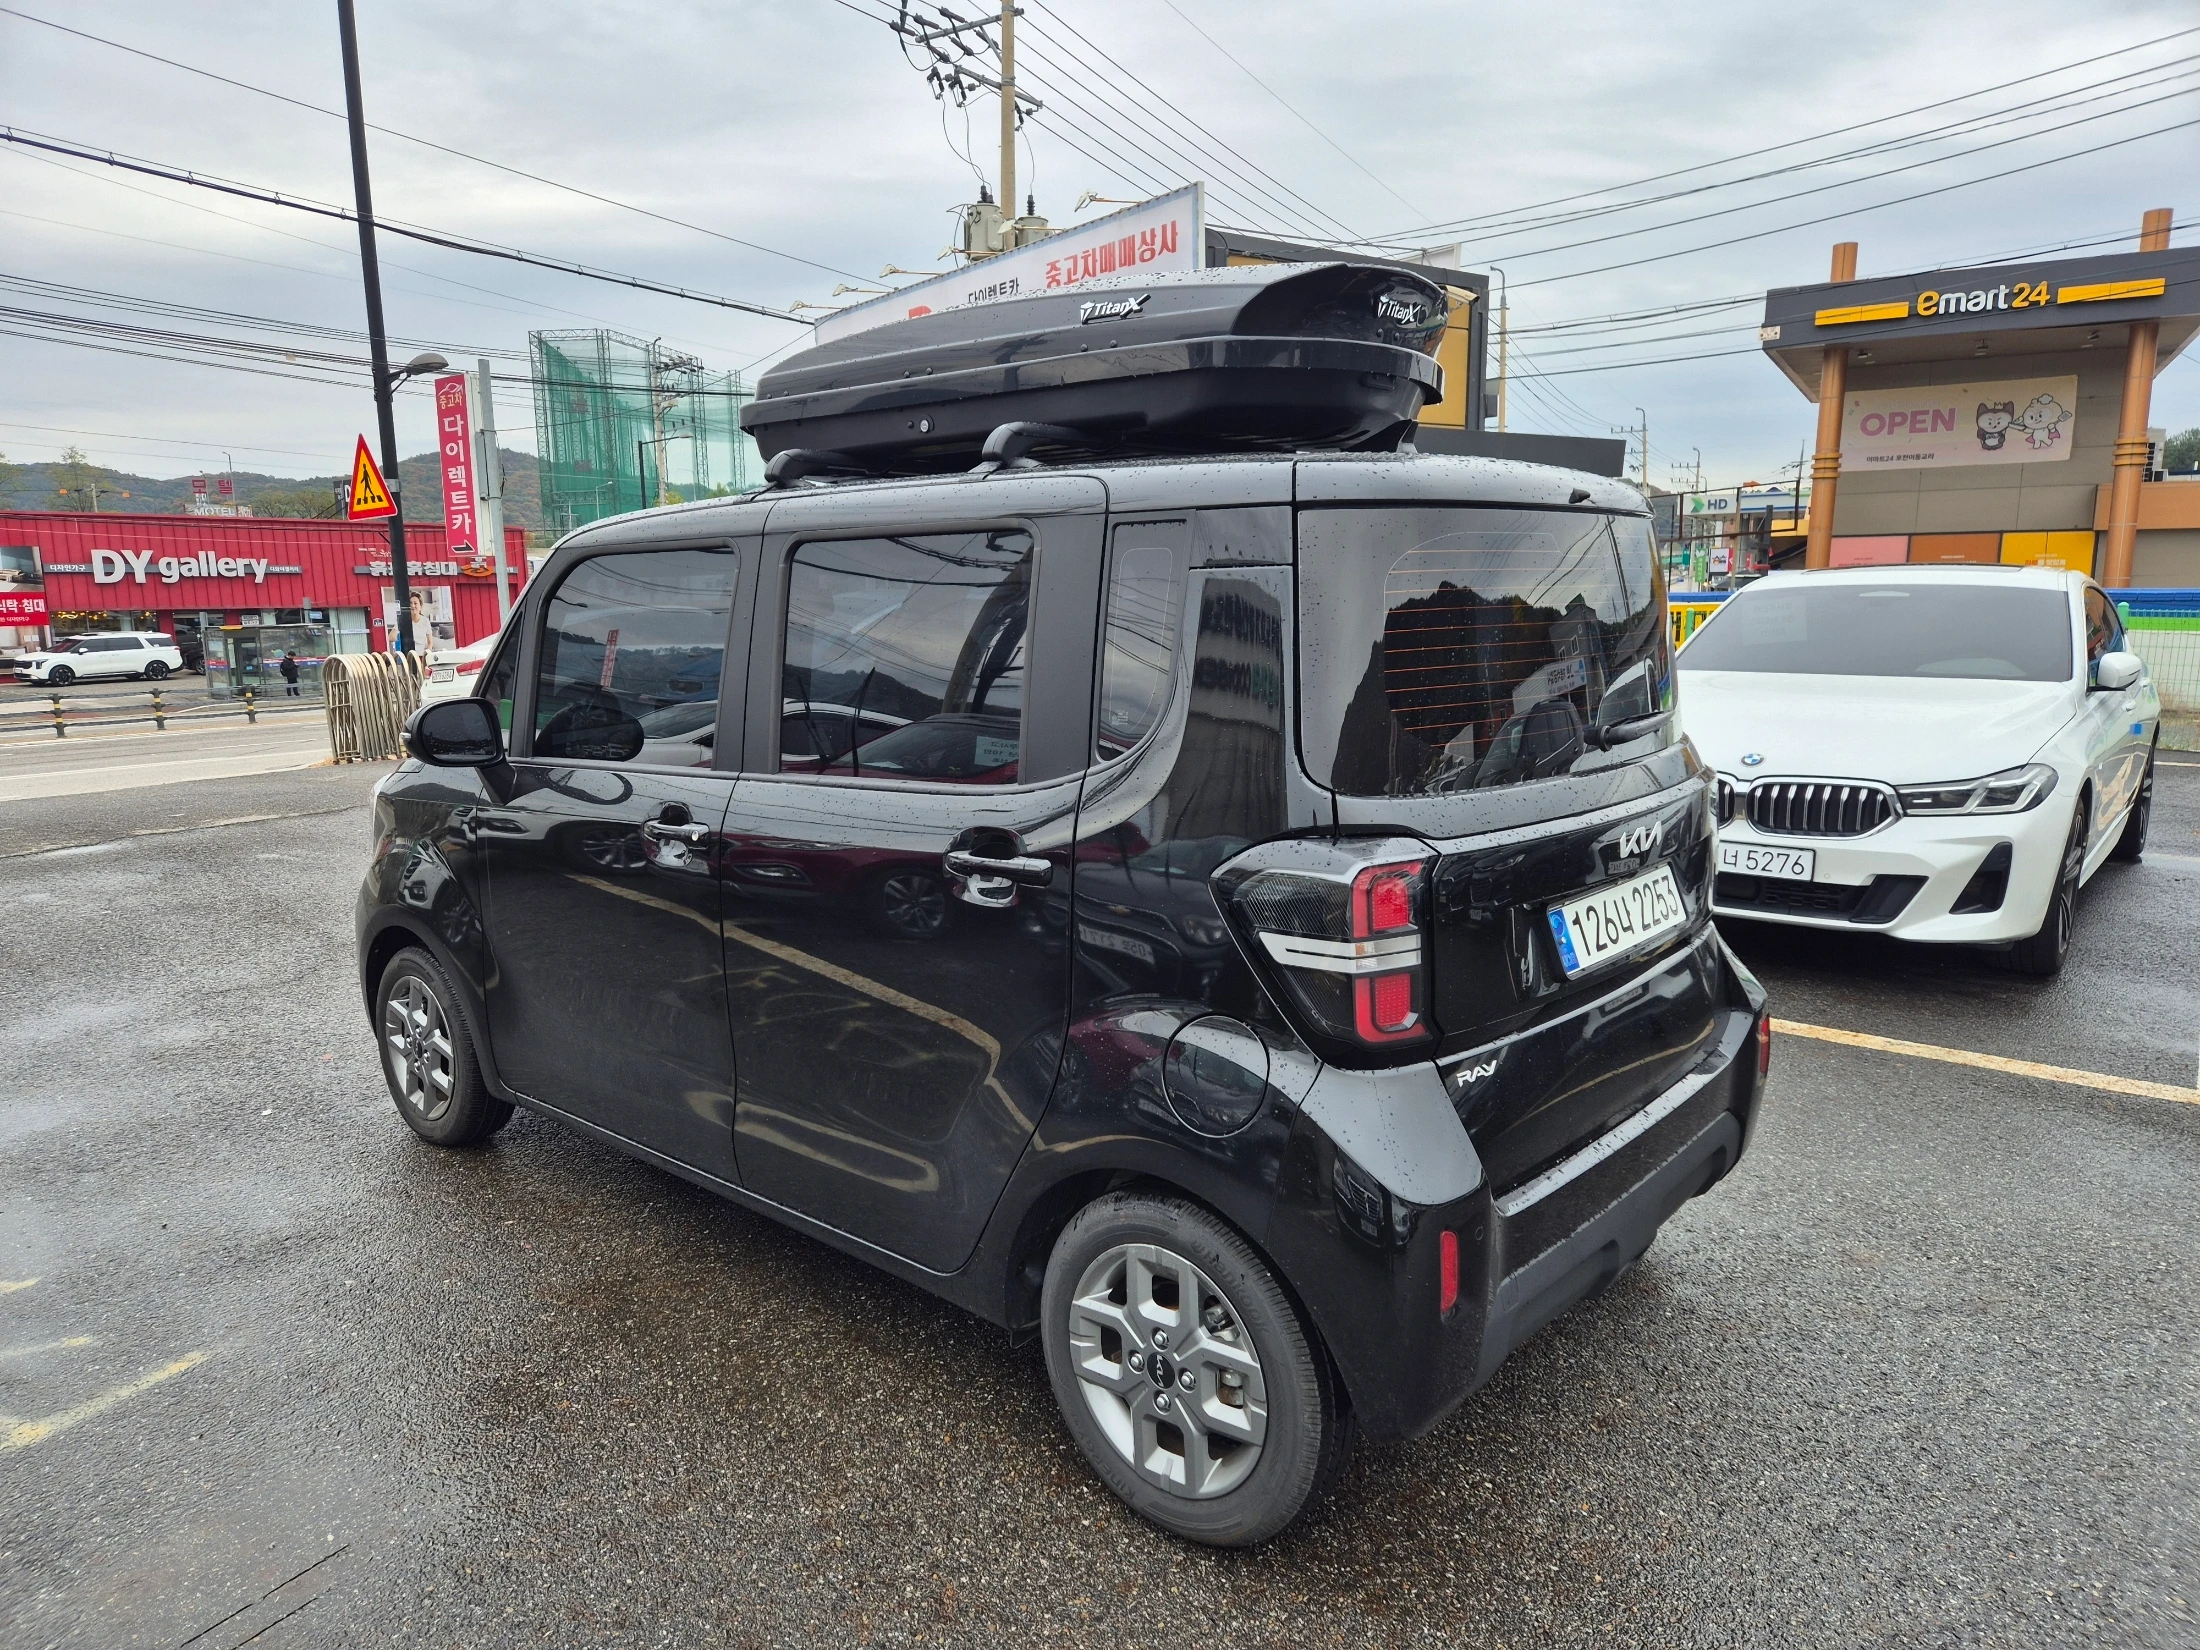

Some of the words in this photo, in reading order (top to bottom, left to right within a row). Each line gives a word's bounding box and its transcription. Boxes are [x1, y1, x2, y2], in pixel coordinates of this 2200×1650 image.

[1045, 219, 1179, 290] 중고차매매상사
[1094, 293, 1152, 319] TitanX
[1387, 299, 1422, 325] TitanX
[439, 391, 463, 410] 중고차
[1859, 407, 1957, 437] OPEN
[443, 414, 472, 535] 다이렉트카
[194, 506, 236, 516] MOTEL
[1707, 498, 1728, 510] HD
[49, 564, 86, 572] 디자인가구
[90, 549, 154, 584] DY
[158, 550, 268, 584] gallery
[369, 560, 458, 576] 흙흙침대
[1745, 850, 1805, 876] 5276
[1571, 895, 1635, 957] 126나
[1631, 874, 1680, 932] 2253
[1456, 1059, 1498, 1088] RAY
